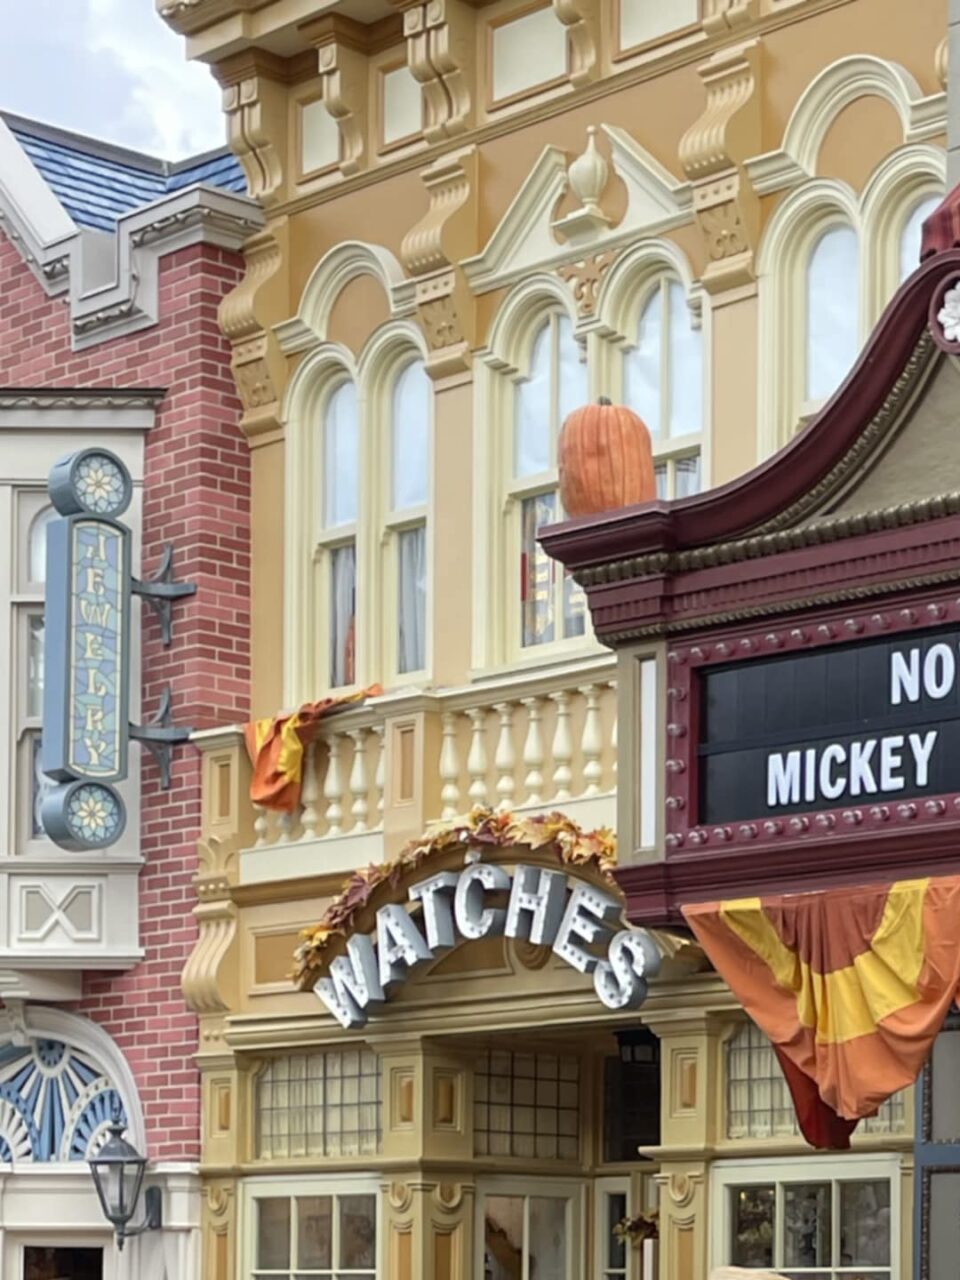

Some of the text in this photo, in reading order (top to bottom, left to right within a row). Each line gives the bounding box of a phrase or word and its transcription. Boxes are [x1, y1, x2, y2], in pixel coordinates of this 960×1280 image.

[80, 535, 112, 765] JEWELRY
[766, 731, 938, 806] MICKEY
[312, 864, 660, 1029] WATCHES
